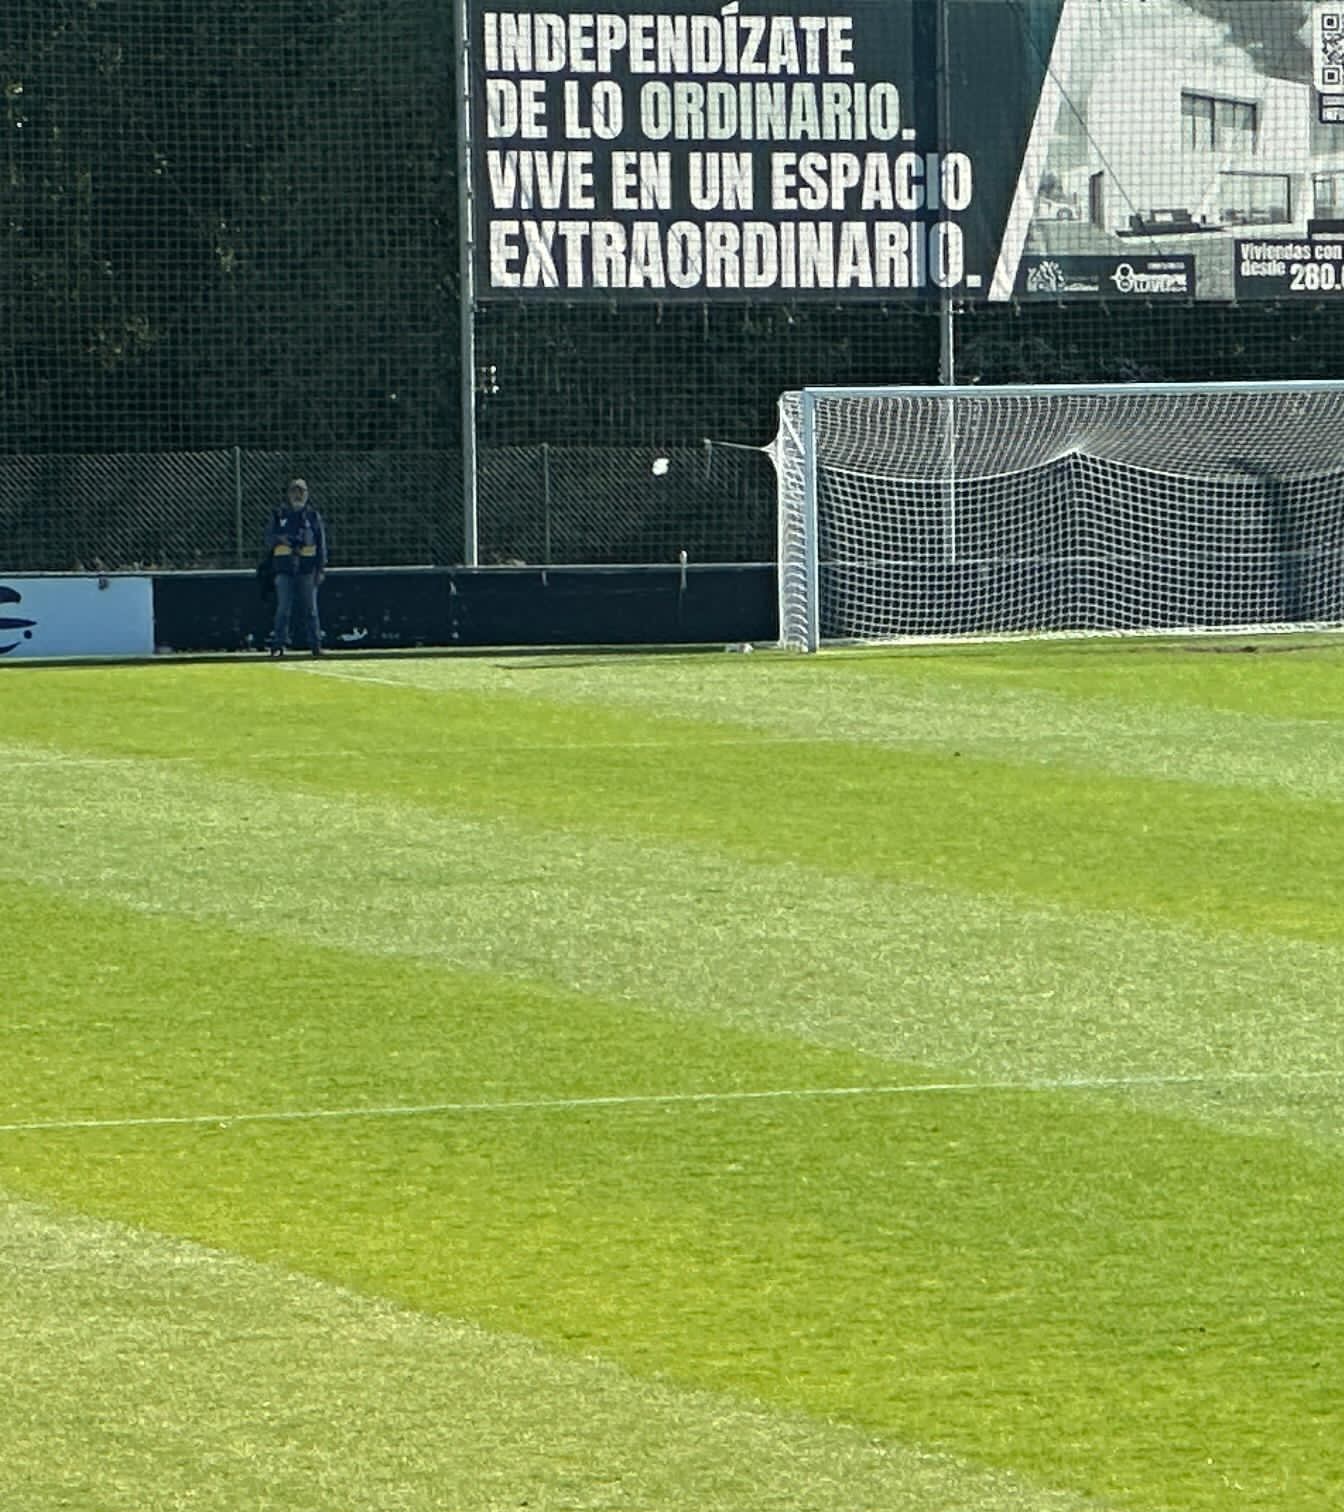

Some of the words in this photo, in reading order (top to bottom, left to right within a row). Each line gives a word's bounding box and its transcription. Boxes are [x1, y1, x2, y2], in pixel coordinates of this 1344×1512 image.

[483, 2, 854, 75] INDEPENDÍZATE
[486, 79, 547, 139] DE
[564, 80, 623, 140] LO
[639, 81, 917, 141] ORDINARIO.
[487, 150, 596, 210] VIVE
[612, 150, 673, 210] EN
[689, 151, 754, 210] UN
[771, 151, 973, 211] ESPACIO
[489, 220, 983, 288] EXTRAORDINARIO.
[1240, 243, 1311, 260] Viviendas
[1314, 245, 1343, 260] con
[1240, 260, 1286, 277] desde
